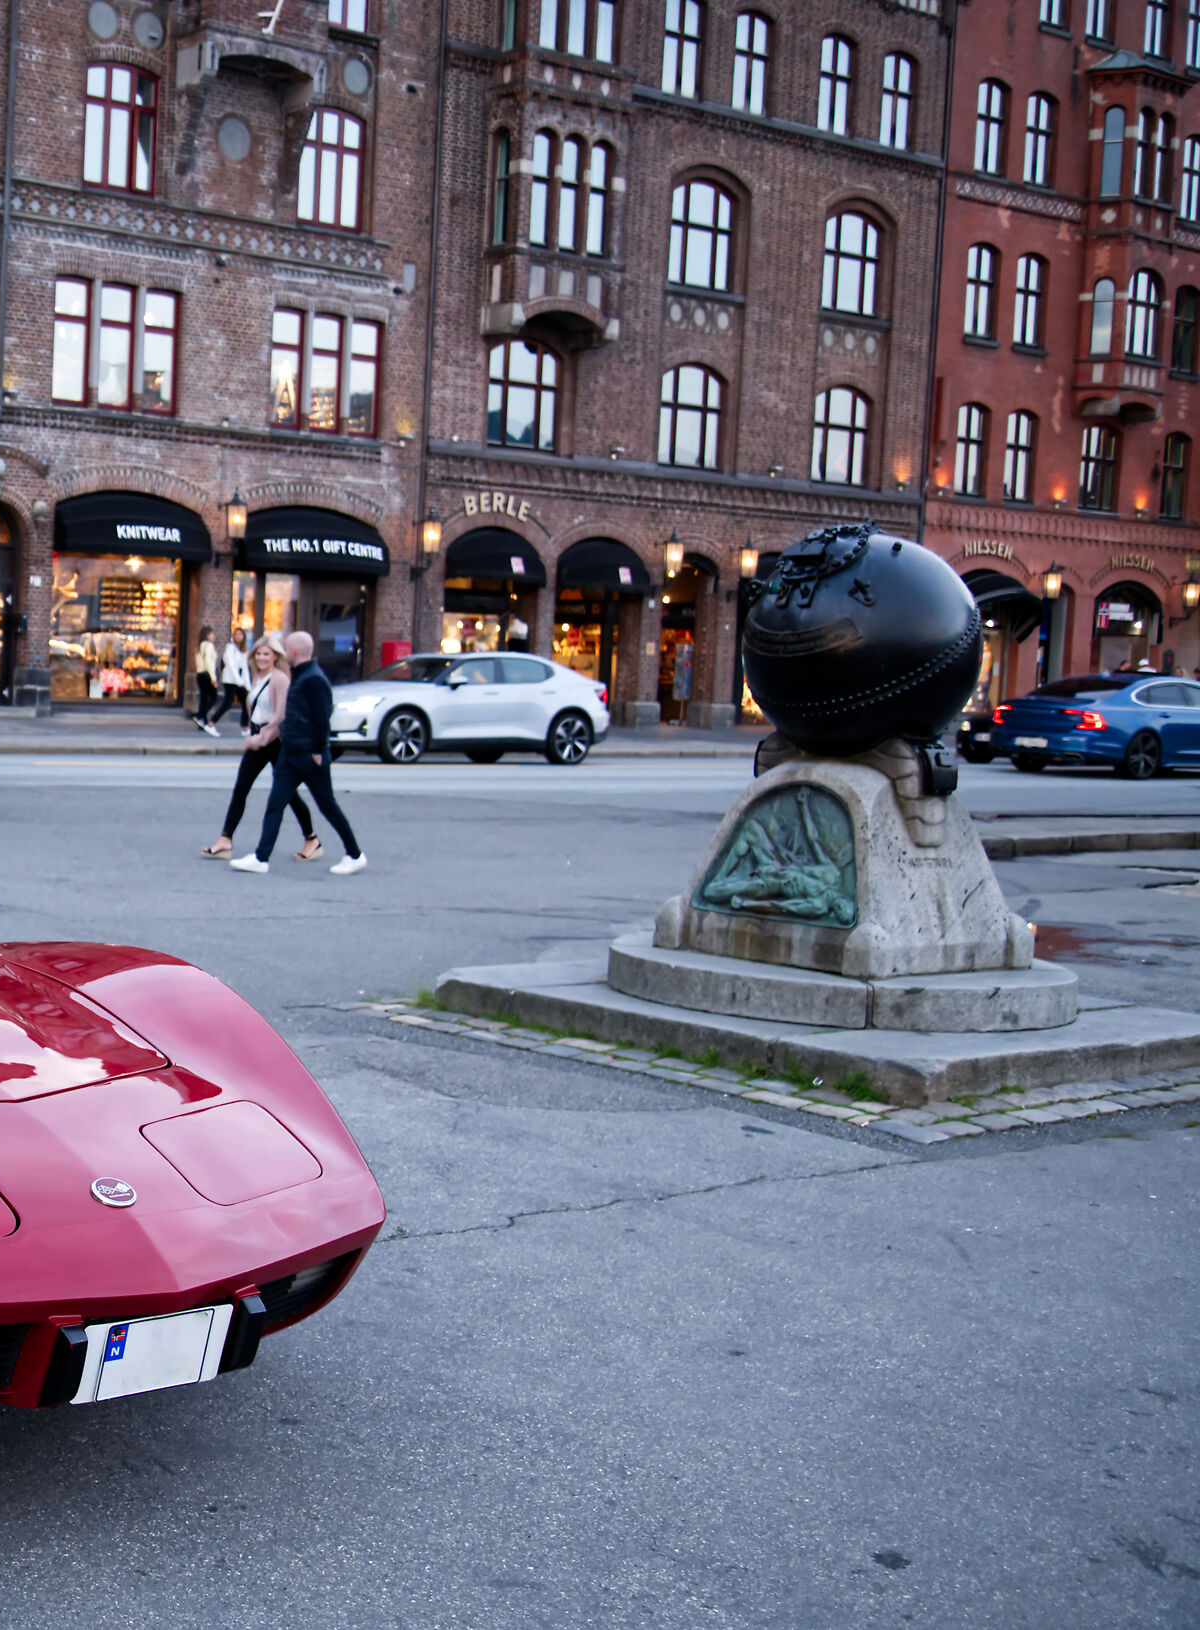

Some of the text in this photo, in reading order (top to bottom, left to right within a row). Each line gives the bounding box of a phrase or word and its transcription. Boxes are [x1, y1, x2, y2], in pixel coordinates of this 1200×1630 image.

[464, 491, 531, 522] BERLE
[116, 524, 181, 542] KNITWEAR
[263, 538, 383, 561] THE NO.1 GIFT CENTRE
[964, 539, 1013, 560] NILSSEN
[1111, 553, 1155, 572] NILSSEN
[110, 1346, 120, 1356] N
